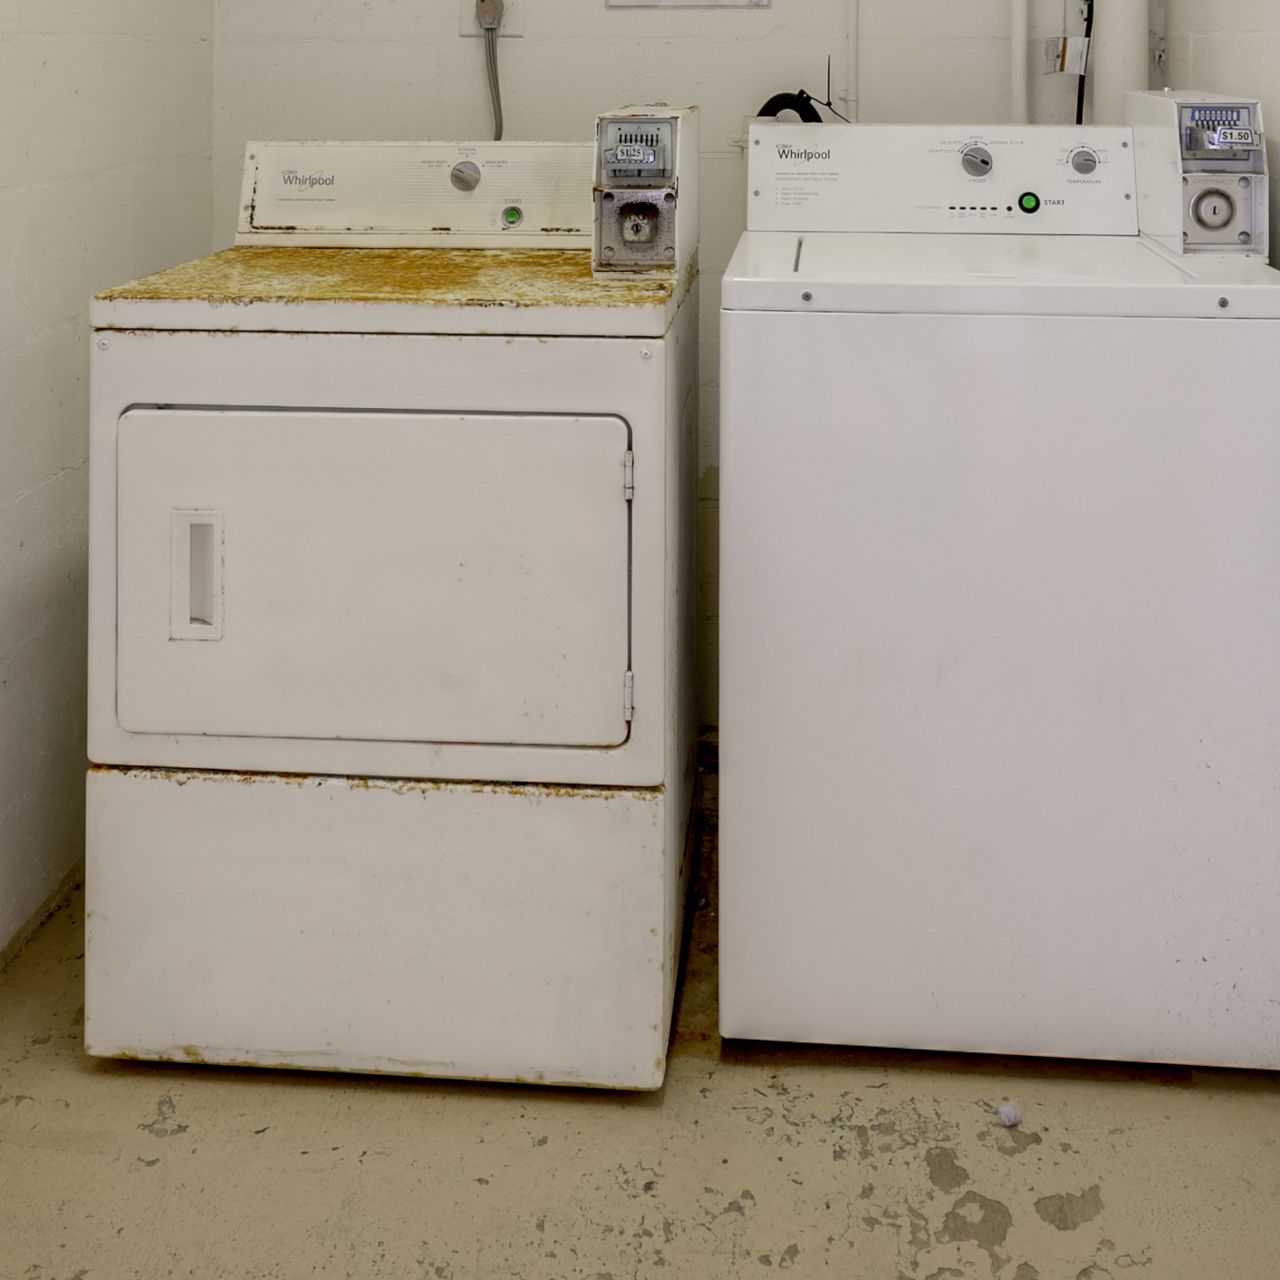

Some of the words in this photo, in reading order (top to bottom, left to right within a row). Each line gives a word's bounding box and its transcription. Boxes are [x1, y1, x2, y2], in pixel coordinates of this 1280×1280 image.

[1222, 132, 1249, 140] $1.50
[778, 149, 830, 162] Whirlpool
[283, 176, 334, 188] Whirlpool
